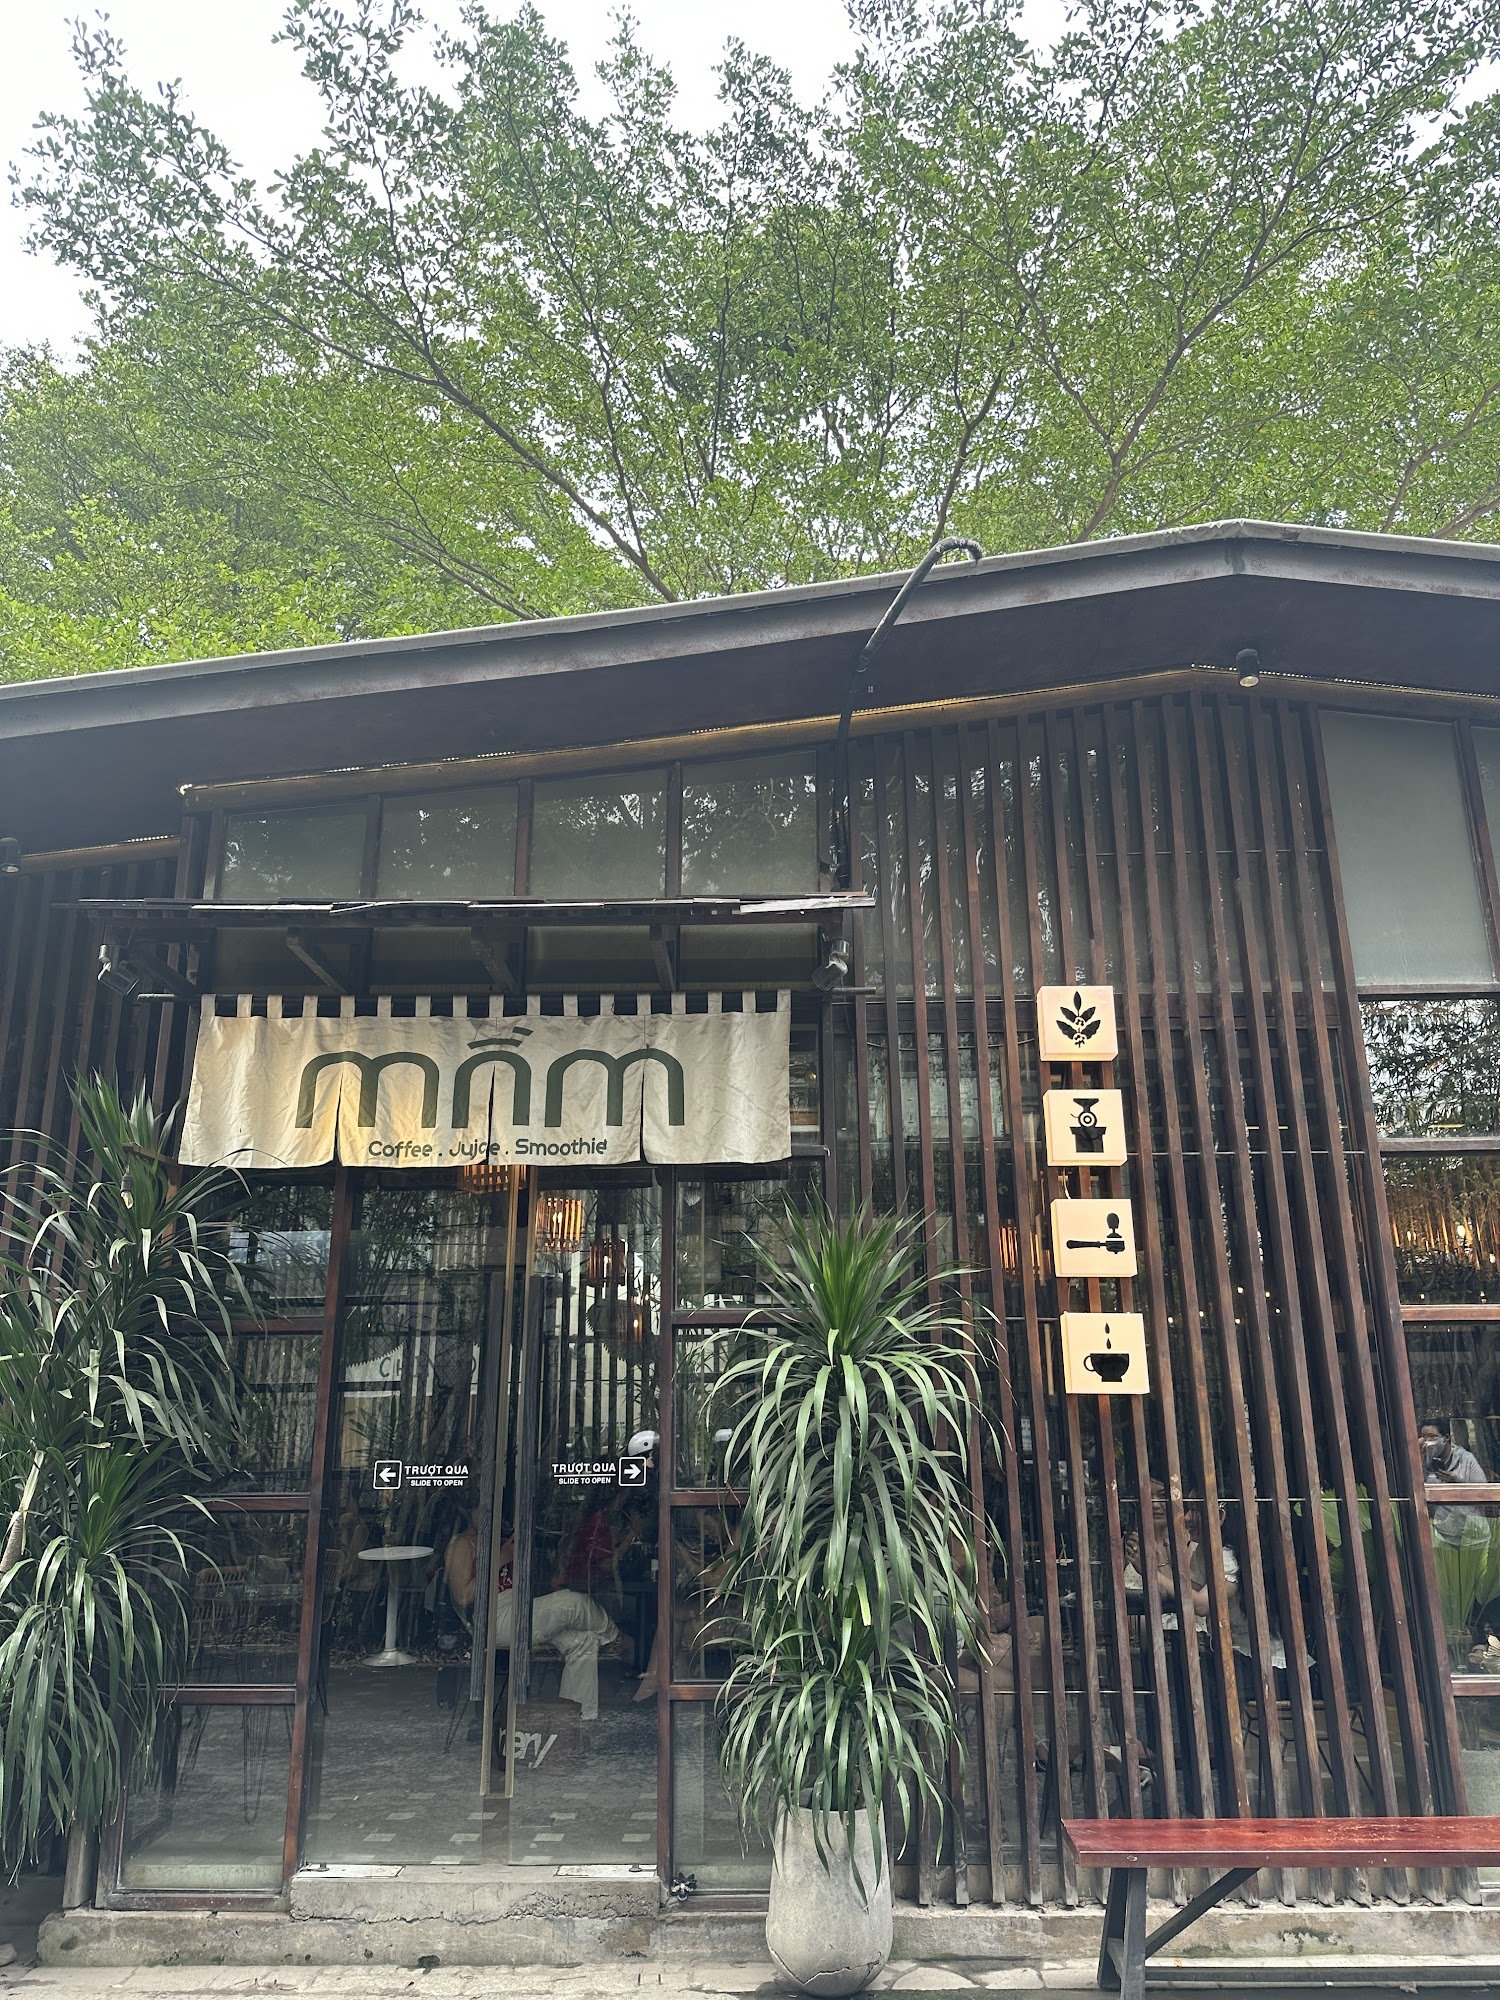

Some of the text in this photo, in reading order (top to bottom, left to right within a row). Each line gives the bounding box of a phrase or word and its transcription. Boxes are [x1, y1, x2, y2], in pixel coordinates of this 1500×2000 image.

[368, 1140, 433, 1158] Coffee
[515, 1137, 608, 1156] Smoothie
[404, 1464, 469, 1477] TRƯỢT QUA
[551, 1462, 617, 1475] TRƯỢT QUA
[410, 1479, 464, 1487] SLIDE TO OPEN
[558, 1476, 612, 1485] SLIDE TO OPEN
